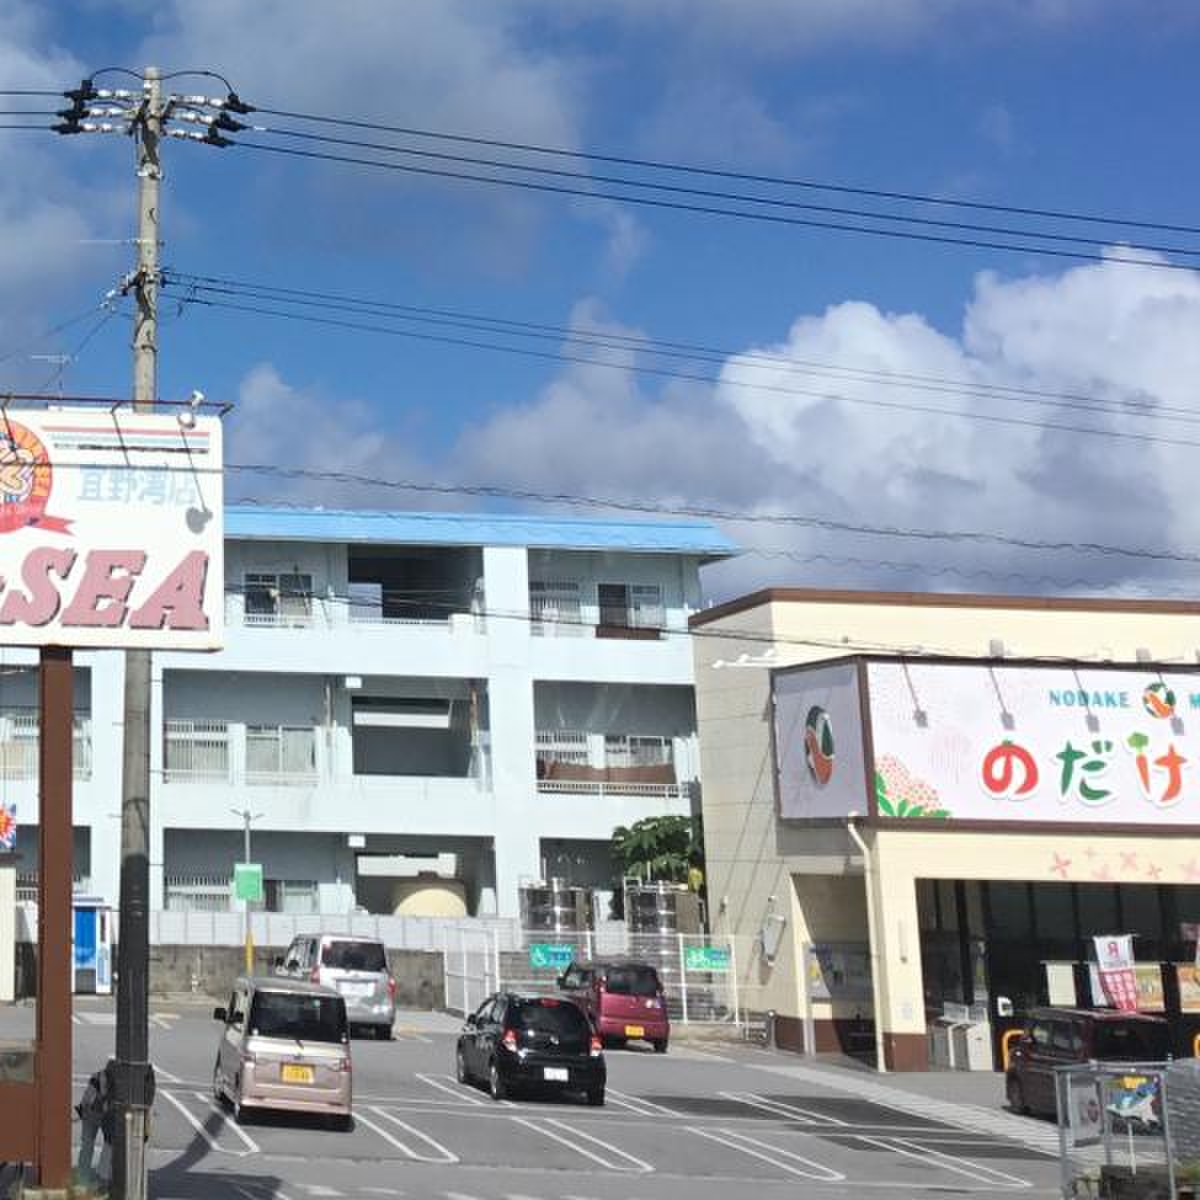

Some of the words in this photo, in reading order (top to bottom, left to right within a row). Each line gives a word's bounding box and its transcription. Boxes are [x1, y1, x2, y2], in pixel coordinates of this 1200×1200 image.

[1049, 688, 1130, 708] NODAKE
[981, 730, 1188, 804] のだけ
